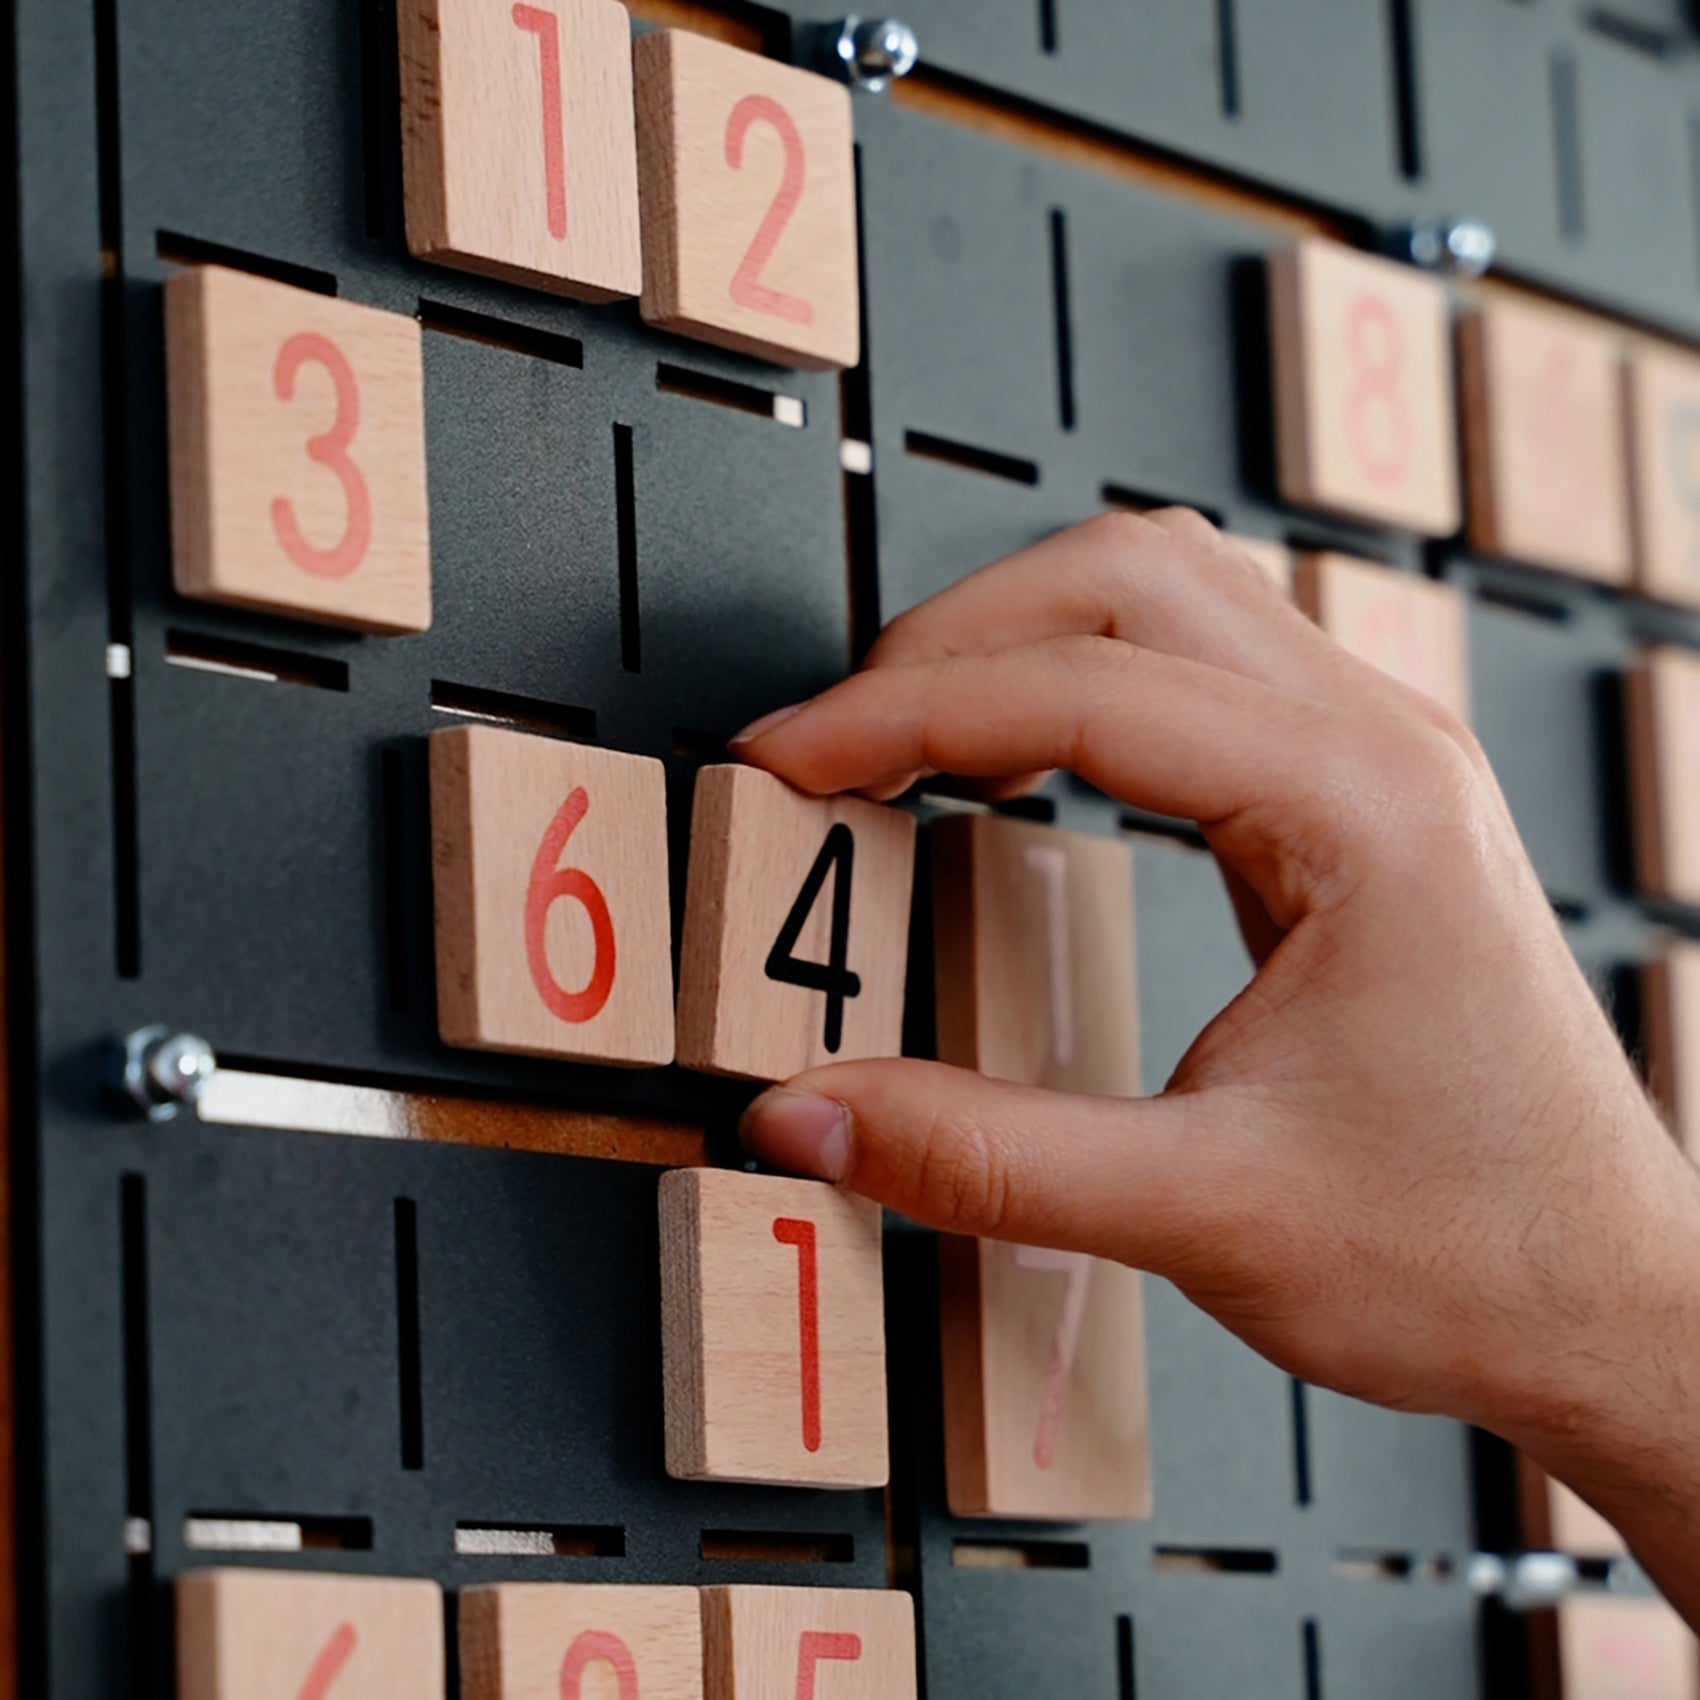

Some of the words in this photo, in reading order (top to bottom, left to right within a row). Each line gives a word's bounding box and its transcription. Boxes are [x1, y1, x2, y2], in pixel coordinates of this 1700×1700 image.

[514, 2, 567, 242] 1
[724, 94, 815, 325] 2
[271, 332, 372, 580] 3
[1345, 291, 1413, 489] 8
[524, 786, 616, 1024] 6
[765, 823, 862, 1054] 4
[773, 1217, 821, 1453] 1
